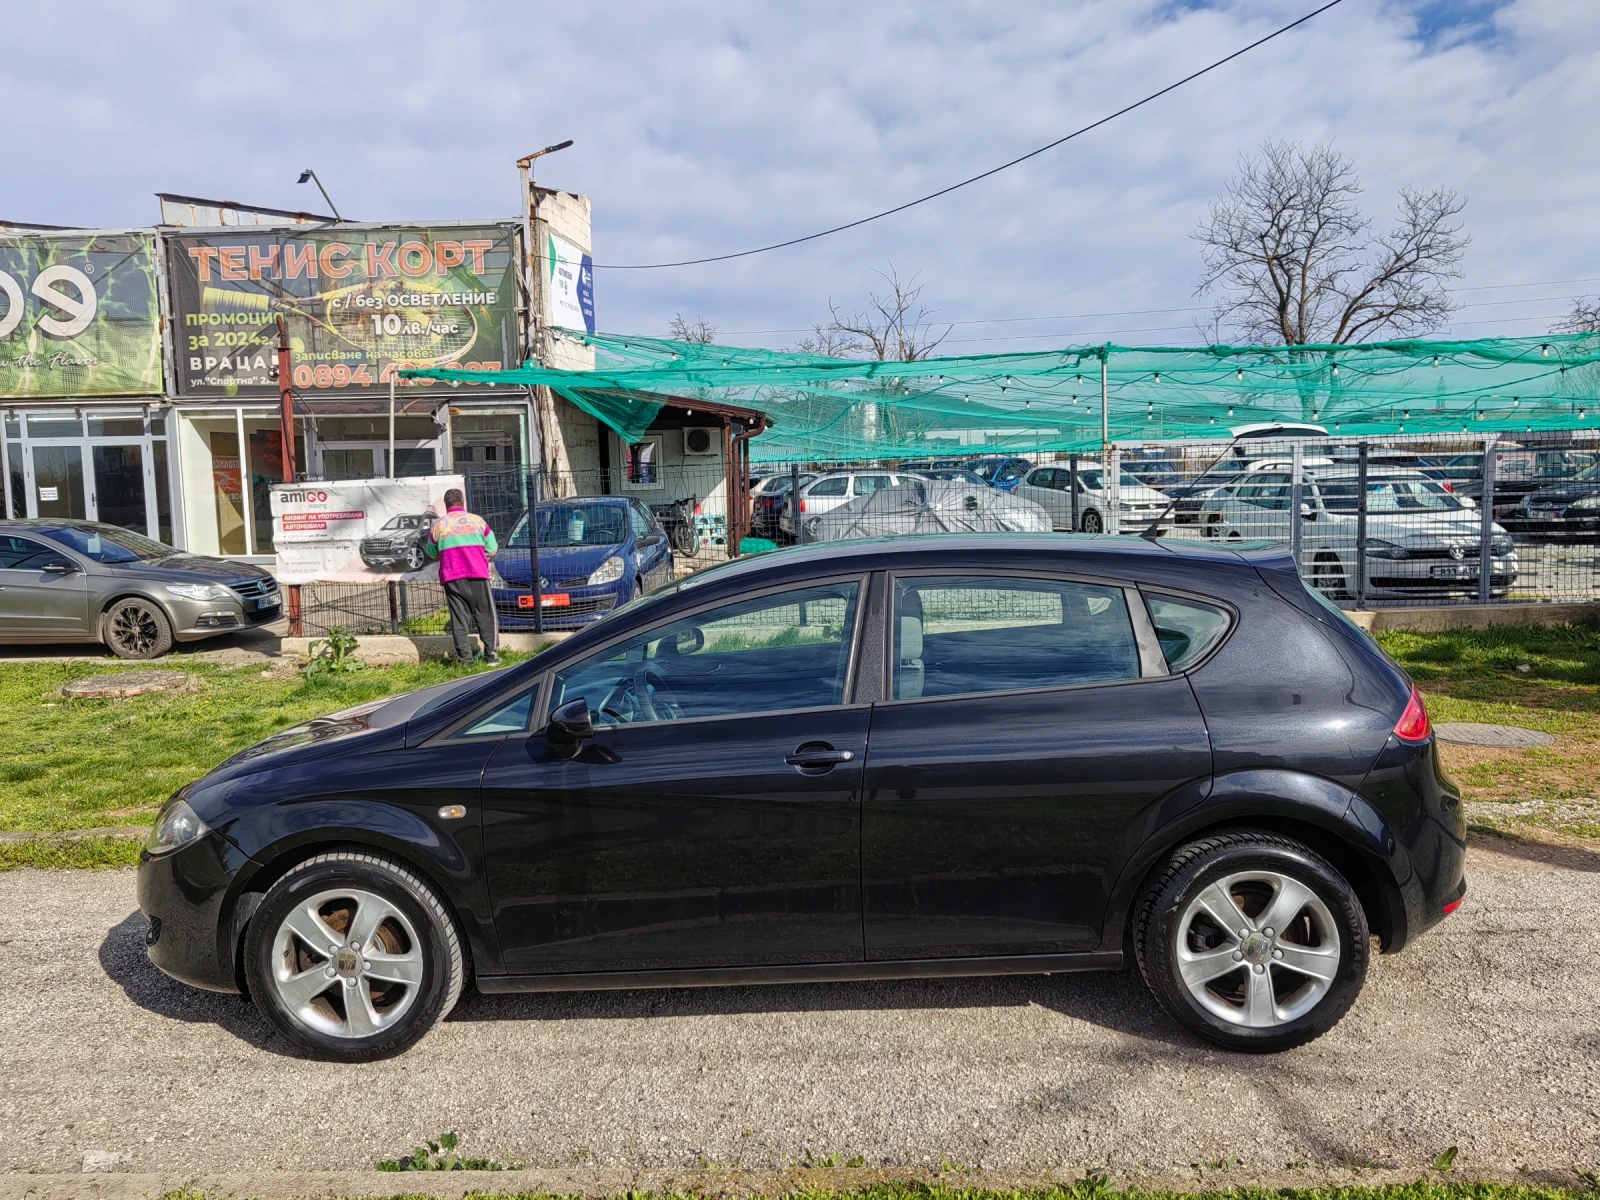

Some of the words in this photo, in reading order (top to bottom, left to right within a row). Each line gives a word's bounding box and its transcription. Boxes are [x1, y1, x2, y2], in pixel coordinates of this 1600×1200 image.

[189, 243, 352, 281] ТЕНИС
[366, 239, 493, 278] КОРТ
[356, 294, 383, 309] без
[386, 292, 496, 306] ОСВЕТЛЕНИЕ
[185, 312, 284, 326] ПРОМОЦИЯ
[188, 335, 209, 351] за
[48, 351, 100, 370] Flavor
[190, 356, 267, 371] ВРАЦА
[294, 350, 362, 363] записване
[366, 350, 381, 359] на
[294, 363, 372, 388] 0894
